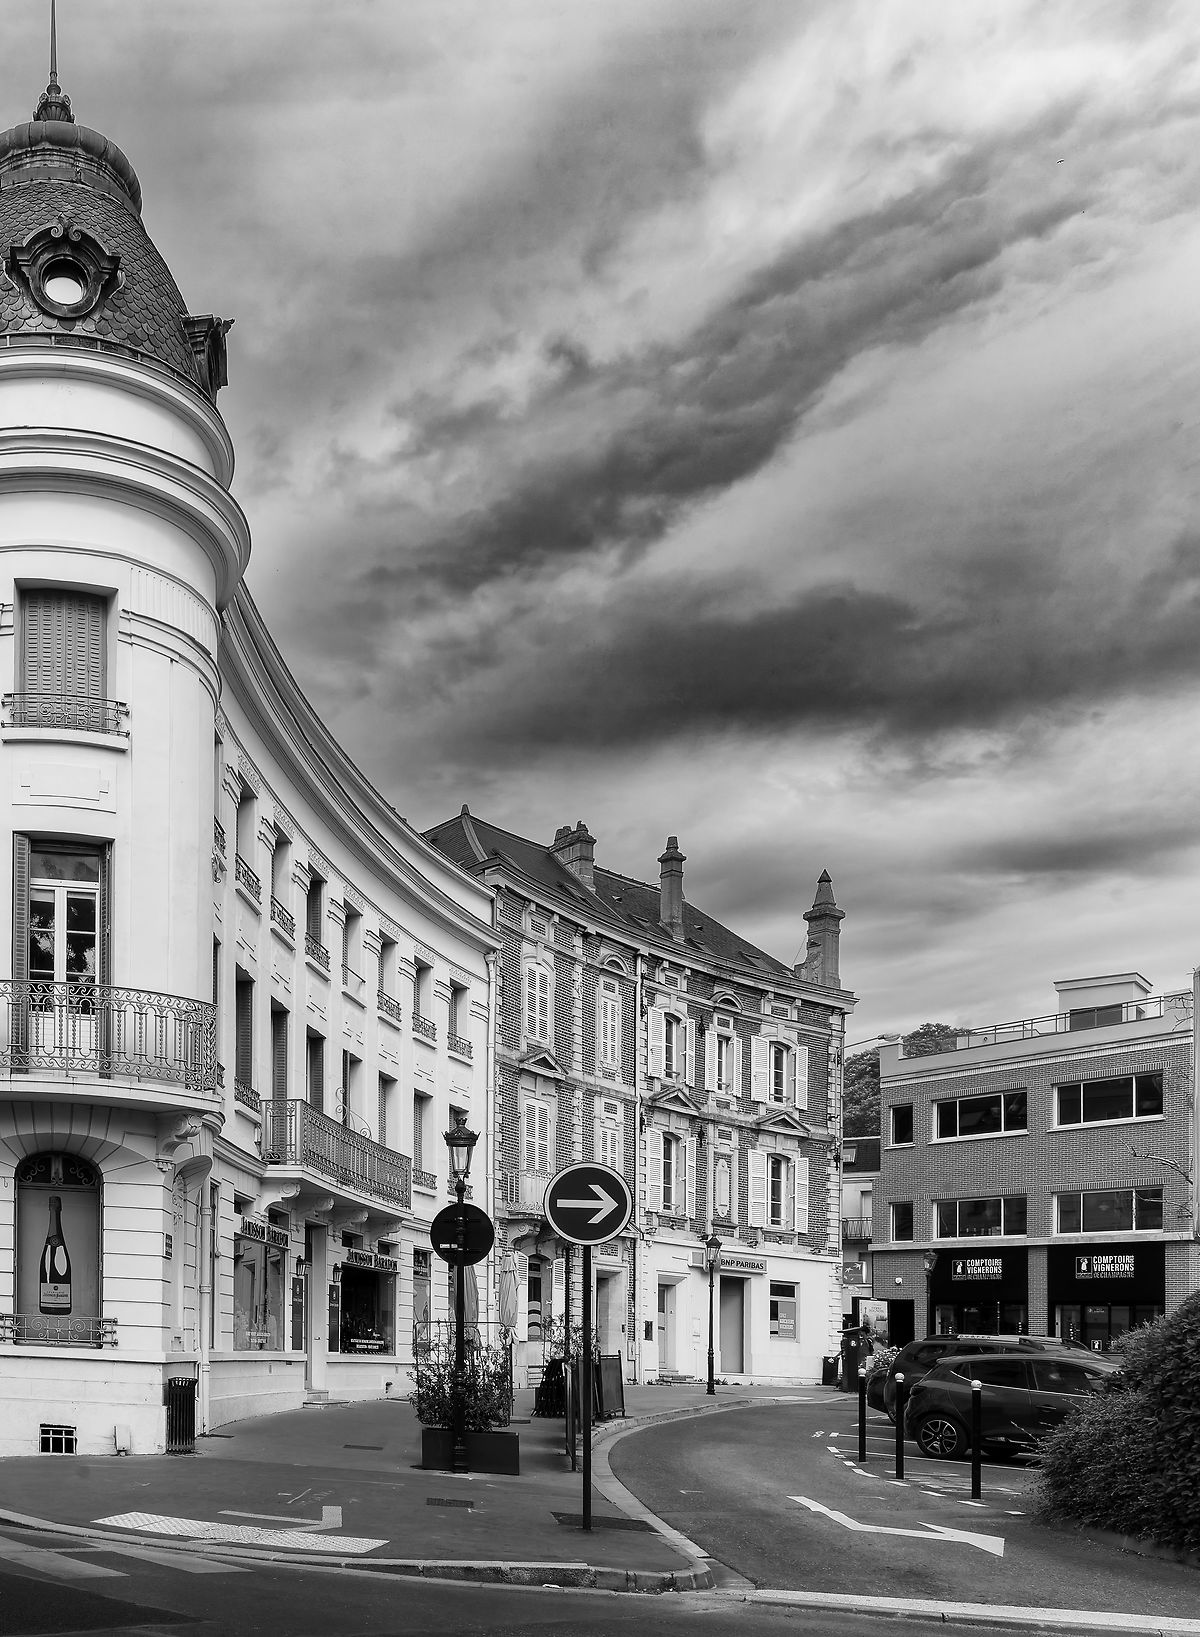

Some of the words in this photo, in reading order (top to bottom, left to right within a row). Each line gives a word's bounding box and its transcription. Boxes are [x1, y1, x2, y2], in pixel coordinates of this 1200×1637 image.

[720, 1258, 736, 1267] BNP
[736, 1260, 764, 1270] PARIBAS
[966, 1258, 998, 1267] COMPTOIR
[1093, 1255, 1130, 1264] COMPTOIR
[966, 1266, 1003, 1274] VIGNERONS
[1093, 1263, 1135, 1272] VIGNERONS
